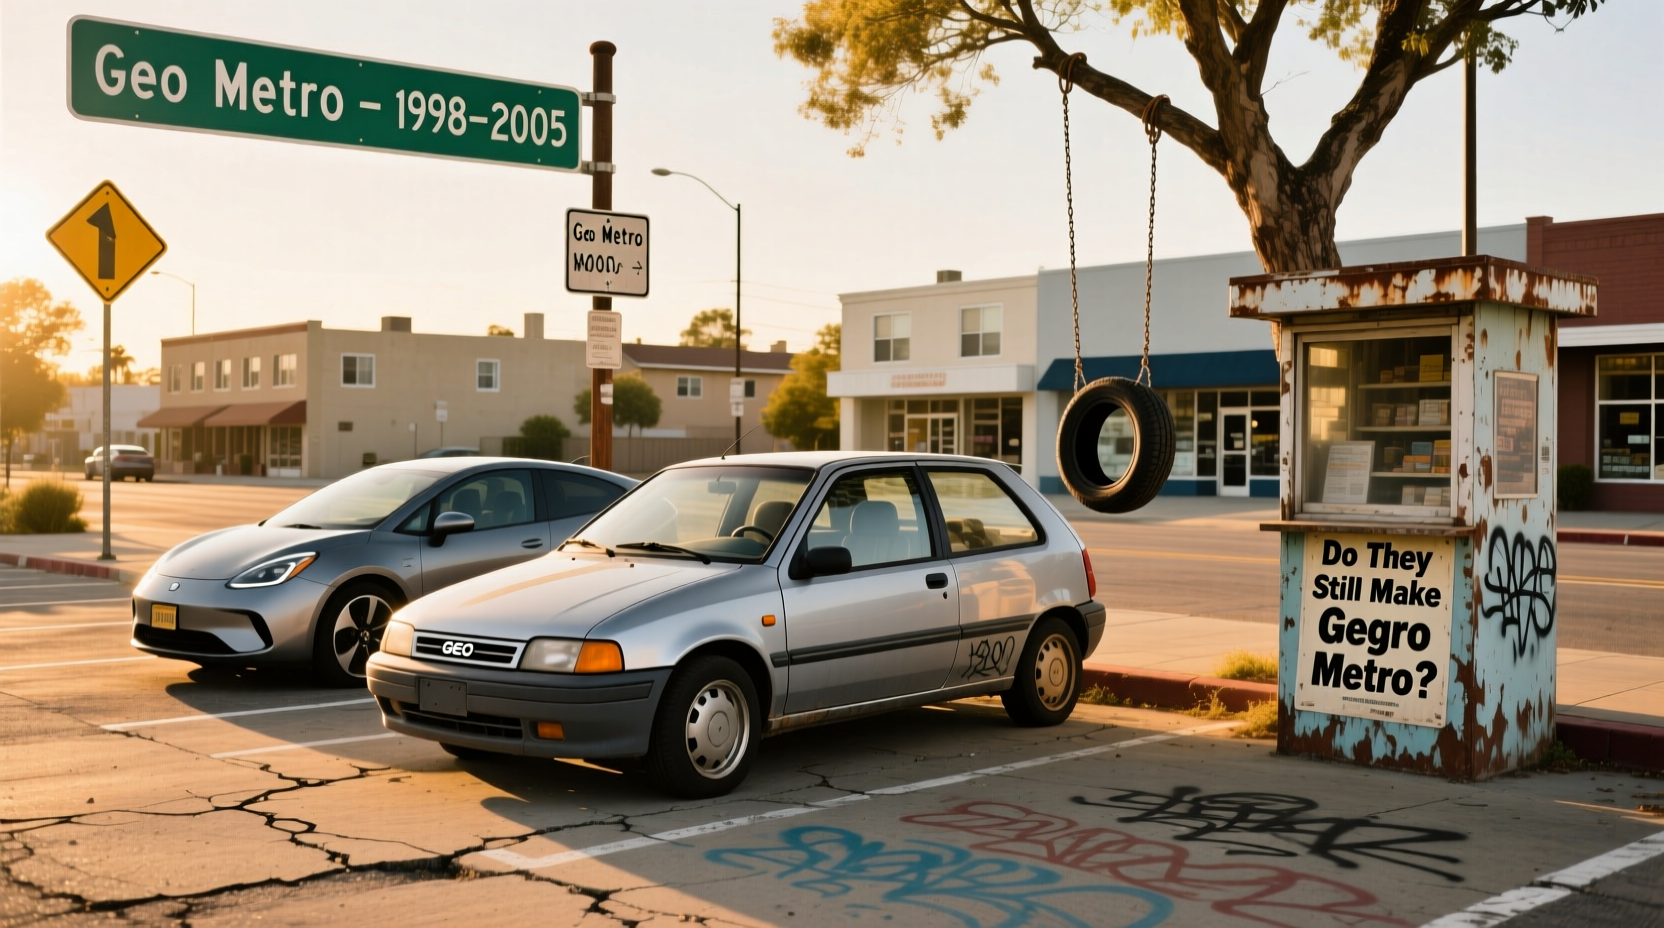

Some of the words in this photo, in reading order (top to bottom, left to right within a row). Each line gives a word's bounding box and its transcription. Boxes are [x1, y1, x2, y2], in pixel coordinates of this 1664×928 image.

[94, 44, 188, 103] Geo
[215, 59, 344, 122] Metro
[602, 224, 643, 247] Metro
[1321, 539, 1358, 567] Do
[1367, 542, 1433, 577] They
[1312, 574, 1363, 602] Still
[1370, 578, 1441, 607] Make
[442, 640, 474, 657] GEO
[1318, 607, 1431, 656] Gegro
[1311, 651, 1438, 699] Metro?
